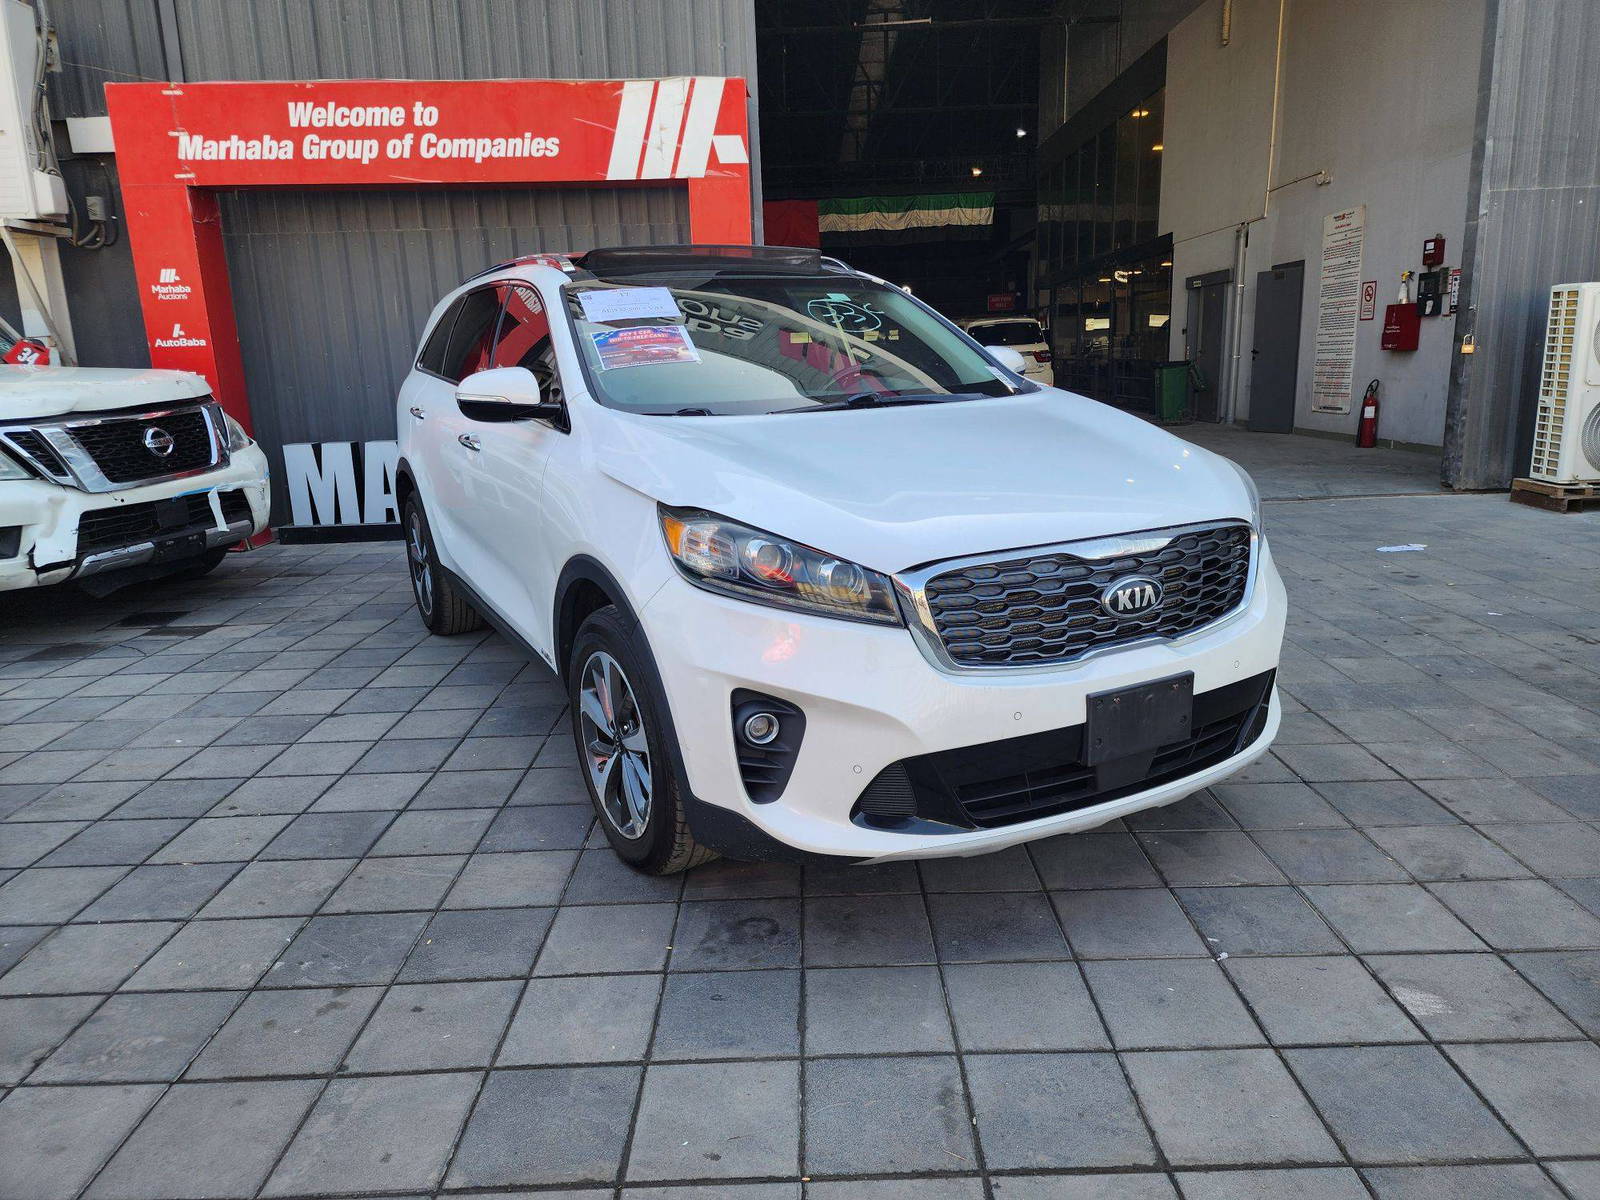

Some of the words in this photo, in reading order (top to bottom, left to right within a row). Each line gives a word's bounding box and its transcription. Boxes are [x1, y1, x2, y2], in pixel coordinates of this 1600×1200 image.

[288, 101, 406, 127] Welcome
[413, 101, 439, 126] to
[178, 135, 294, 160] Marhaba
[302, 133, 379, 164] Group
[386, 132, 414, 159] of
[420, 132, 560, 163] Companies
[152, 285, 192, 294] Marhaba
[155, 338, 206, 348] AutoBaba
[17, 347, 40, 366] 34
[1117, 585, 1156, 611] KIA
